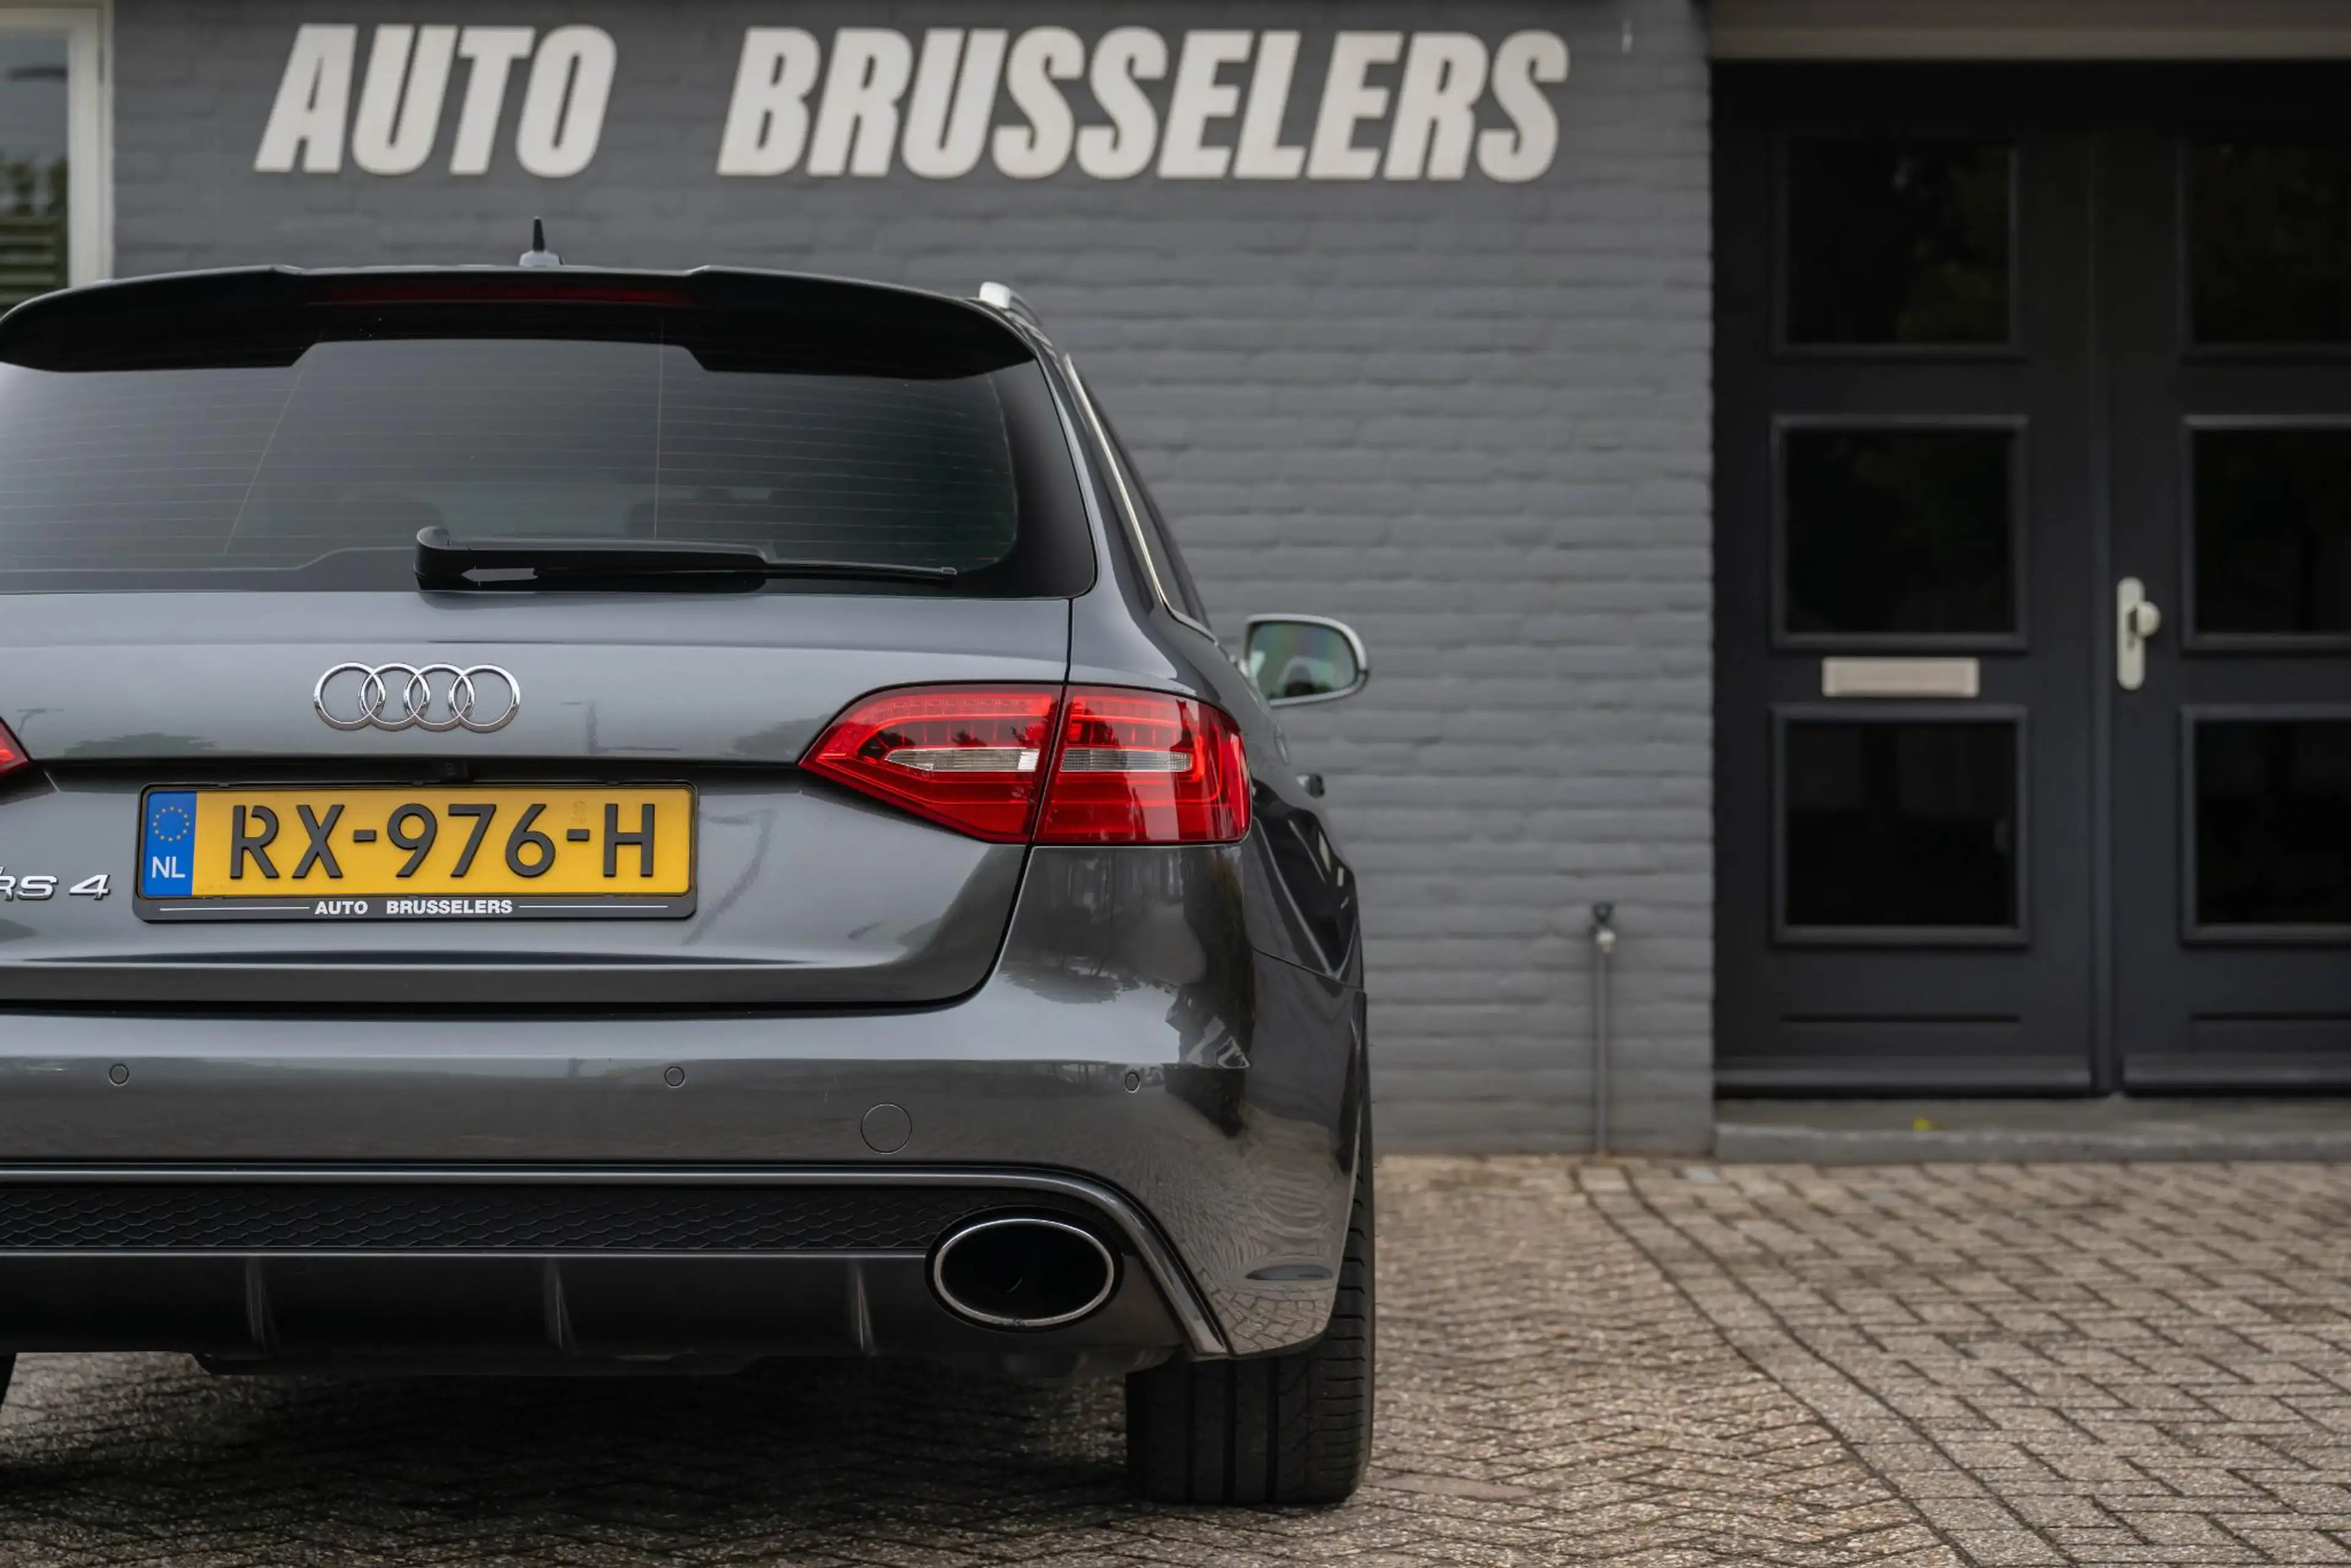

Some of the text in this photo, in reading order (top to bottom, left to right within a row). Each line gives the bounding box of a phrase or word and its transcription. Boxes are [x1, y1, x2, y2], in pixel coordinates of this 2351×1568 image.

[253, 23, 1569, 182] AUTO BRUSSELERS
[229, 802, 656, 880] RX-976-H
[151, 856, 186, 879] NL
[69, 874, 110, 899] 4
[314, 899, 513, 915] AUTO BRUSSELERS
